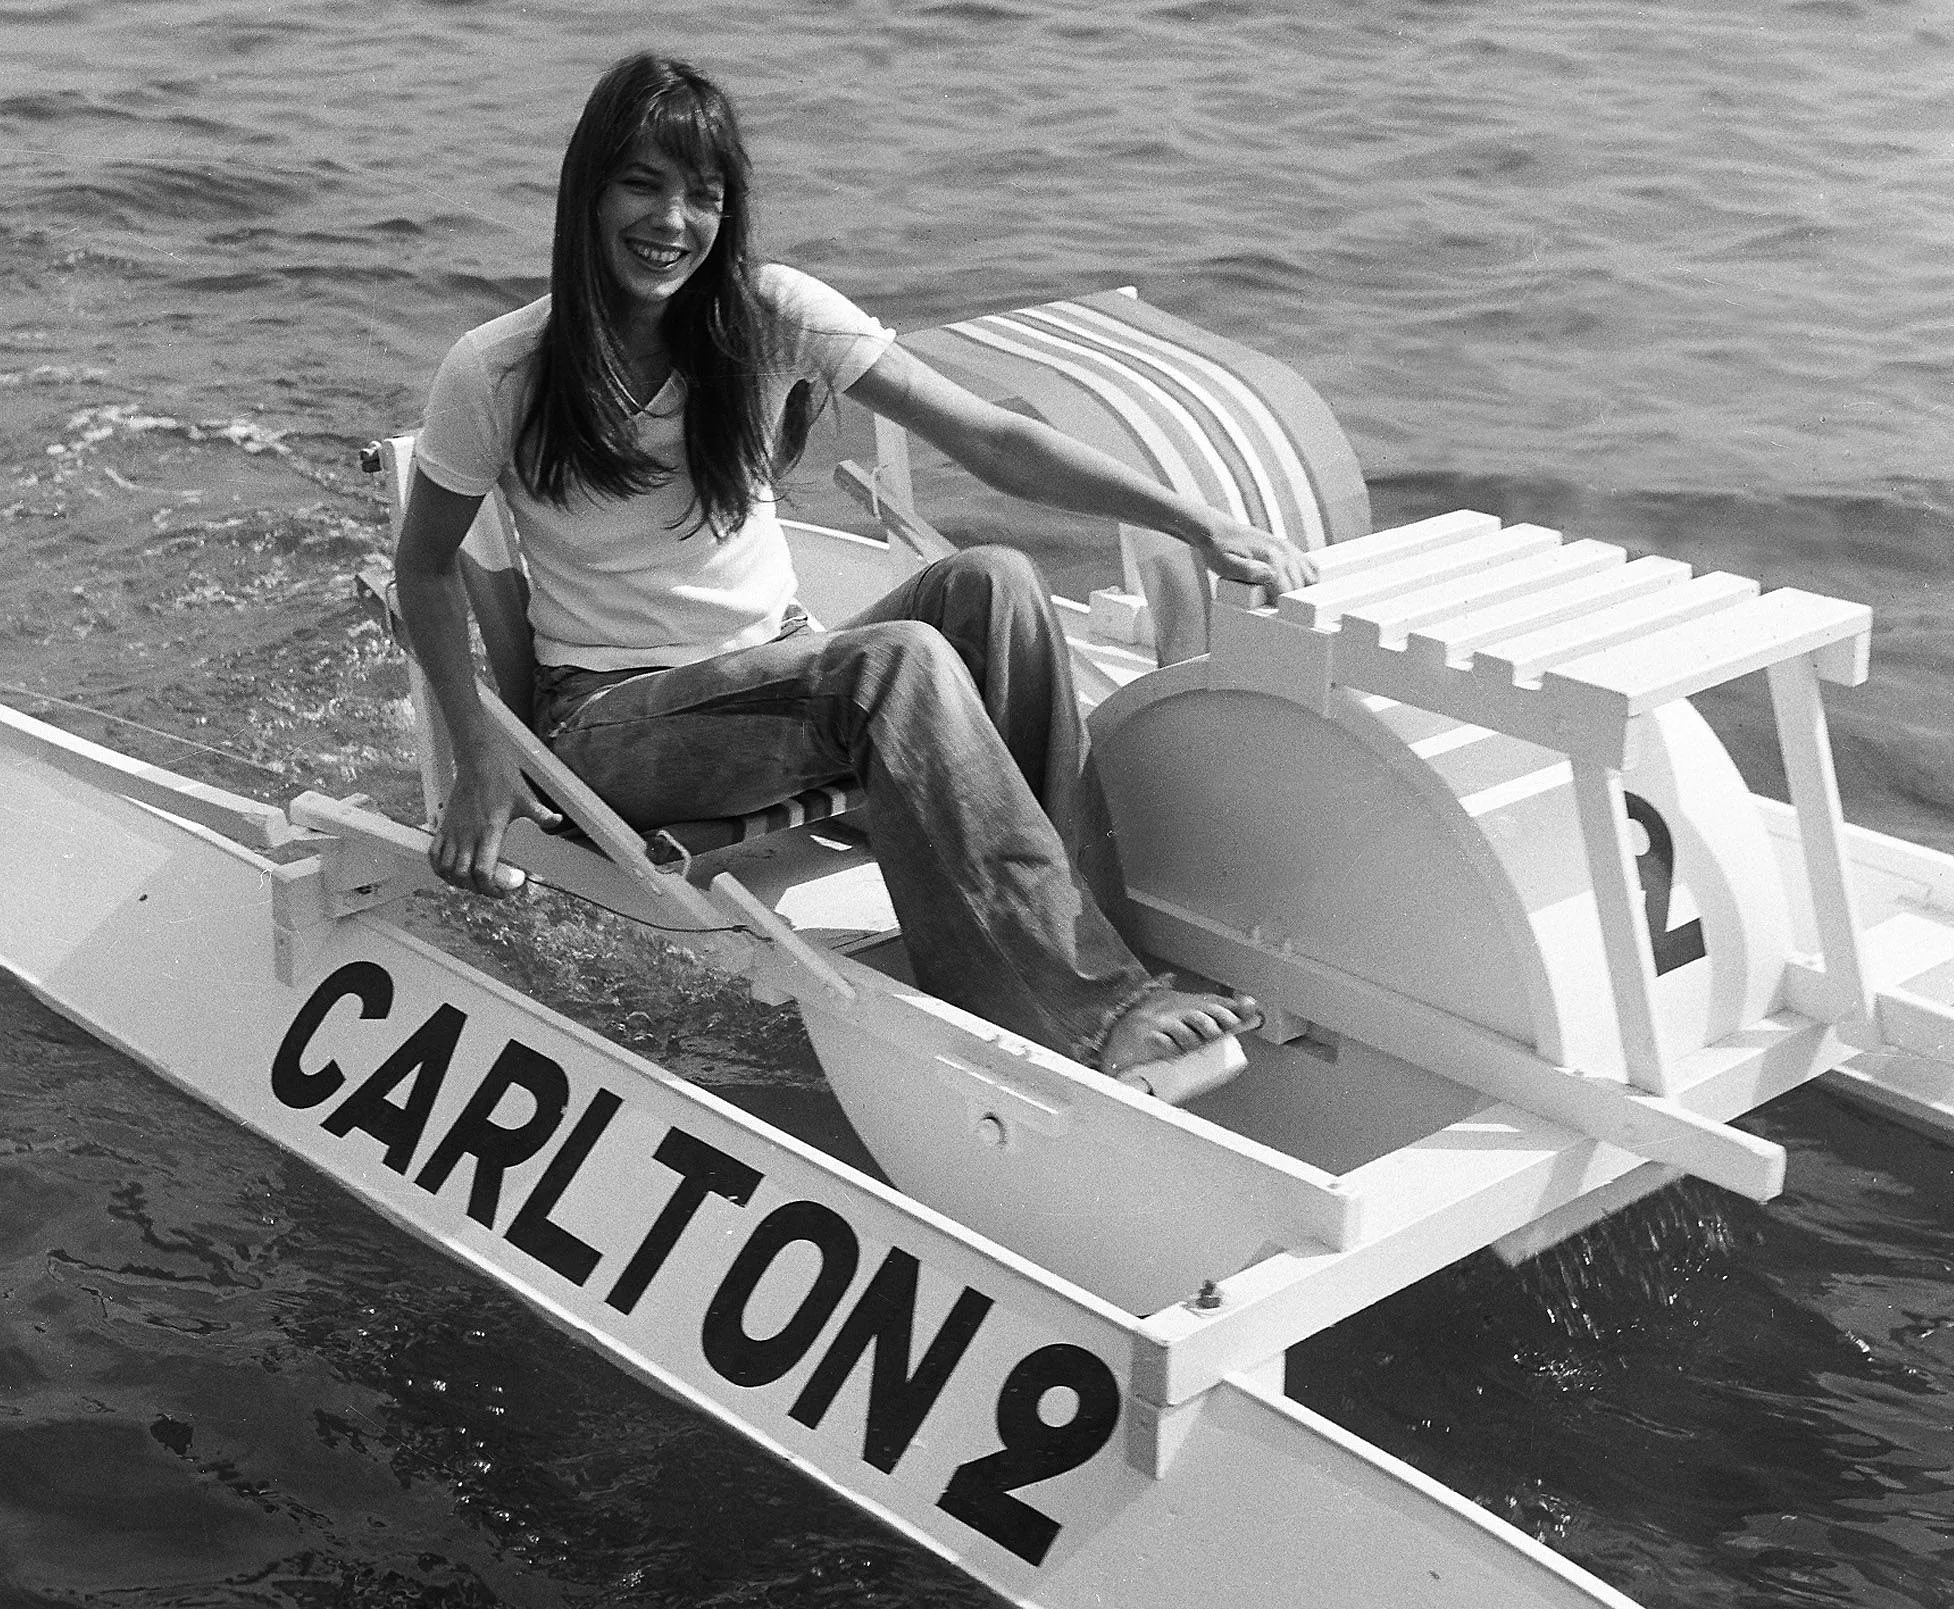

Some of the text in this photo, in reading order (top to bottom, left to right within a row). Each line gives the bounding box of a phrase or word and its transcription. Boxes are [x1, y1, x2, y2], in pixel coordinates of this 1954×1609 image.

[1623, 790, 1706, 977] 2
[271, 961, 1120, 1567] CARLTON 2
